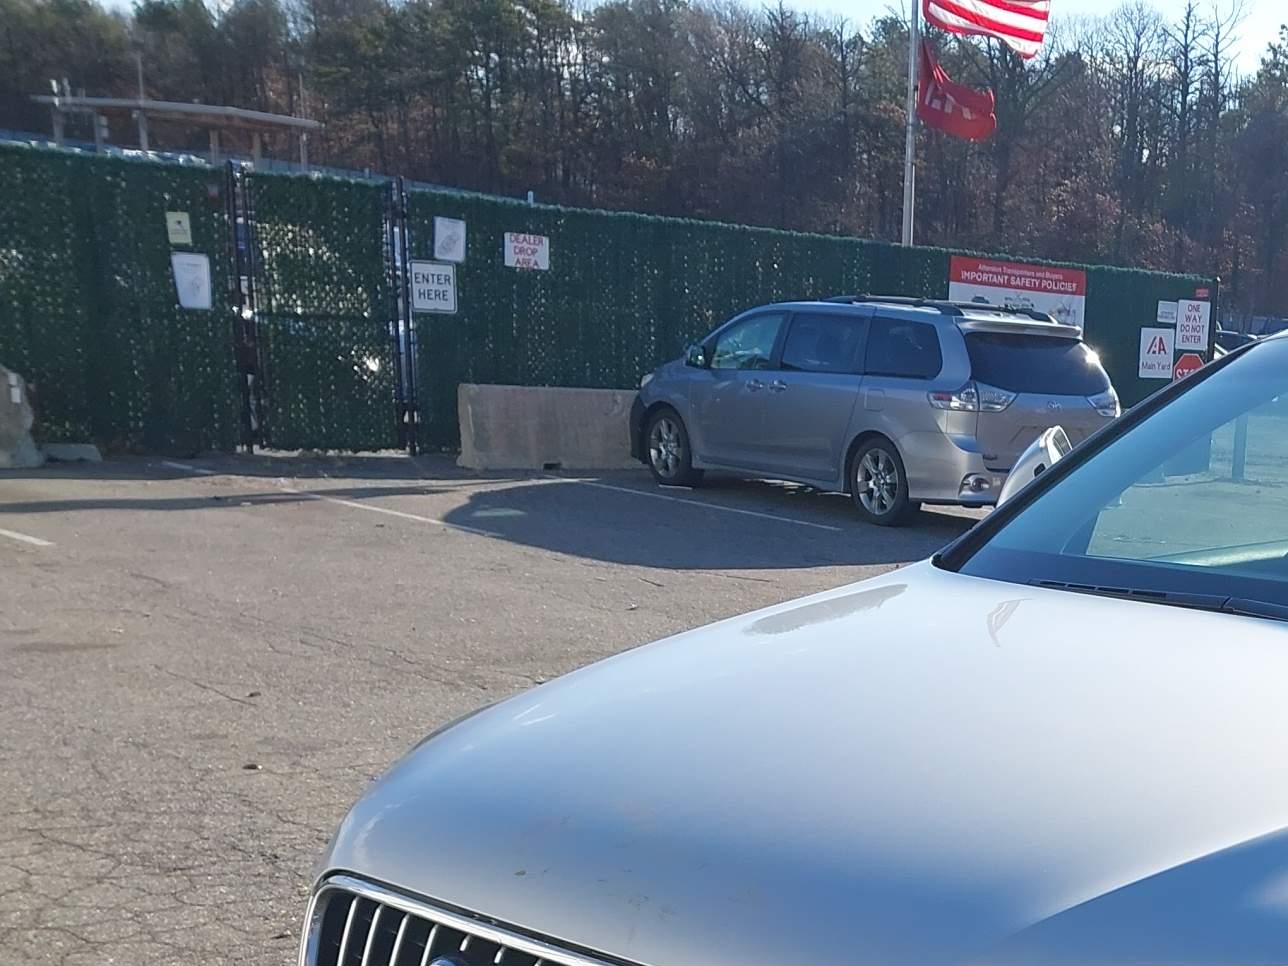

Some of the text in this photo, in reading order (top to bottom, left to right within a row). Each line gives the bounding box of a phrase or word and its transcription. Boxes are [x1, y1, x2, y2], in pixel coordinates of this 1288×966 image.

[510, 234, 544, 246] DEALER
[513, 245, 538, 255] DROP
[515, 258, 540, 267] AREA
[414, 272, 451, 286] ENTER
[961, 270, 1077, 292] IMPORTANT SAFETY POLICIES
[418, 289, 449, 302] HERE
[1187, 304, 1201, 312] ONE
[1185, 314, 1202, 322] WAY
[1180, 324, 1205, 333] DO NOT
[1181, 335, 1201, 344] ENTER
[1141, 361, 1171, 370] Main Yard
